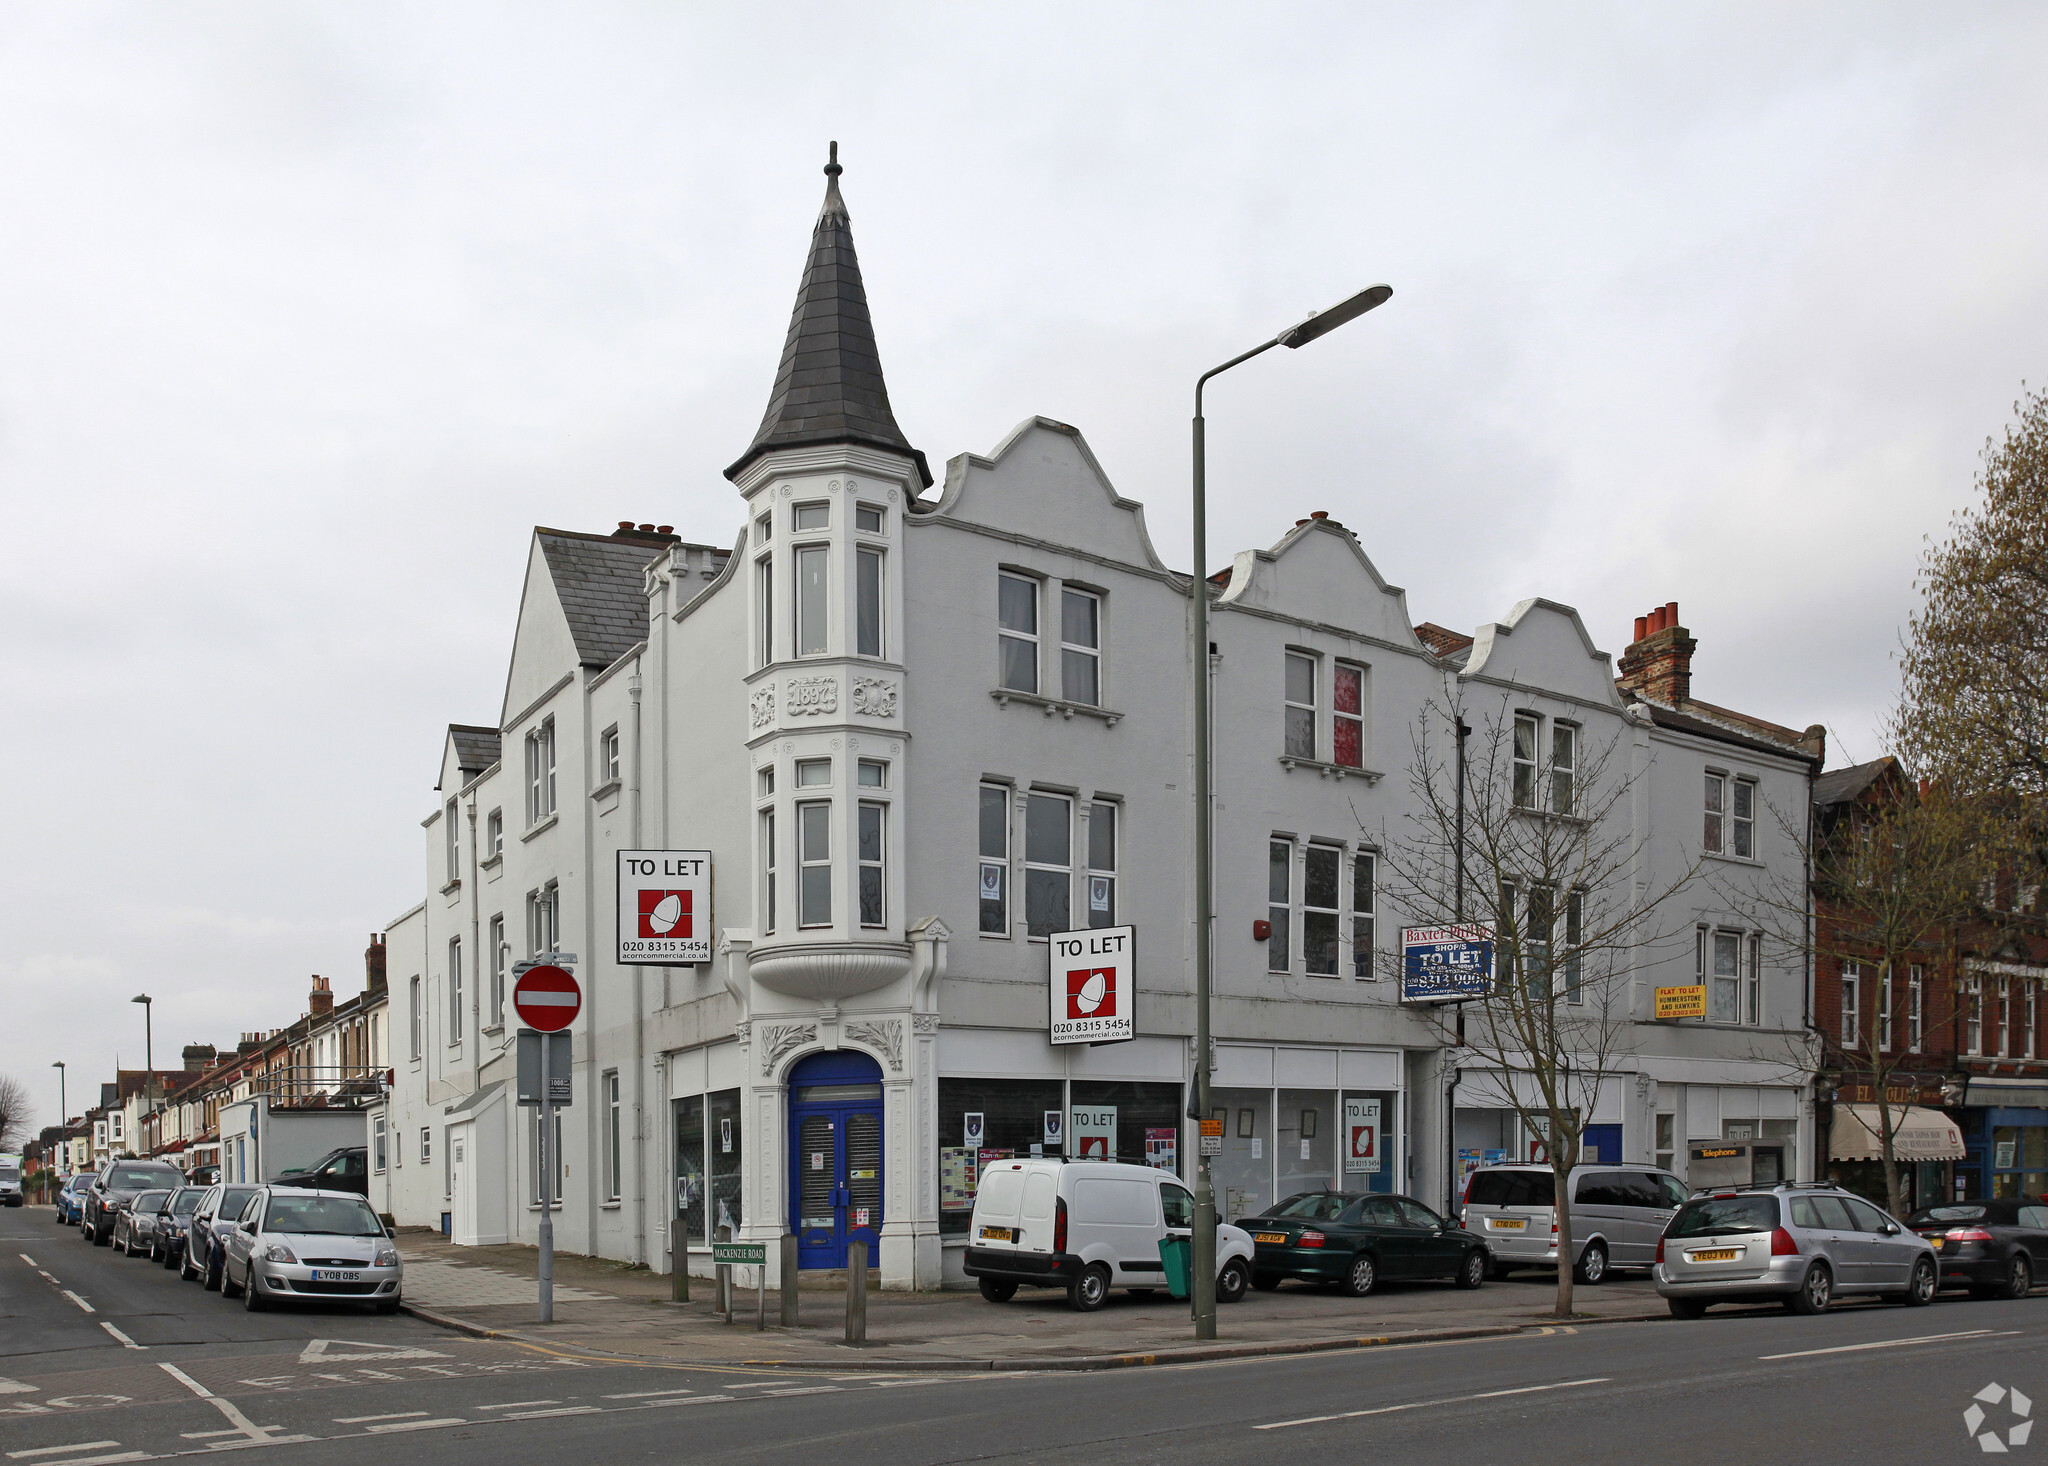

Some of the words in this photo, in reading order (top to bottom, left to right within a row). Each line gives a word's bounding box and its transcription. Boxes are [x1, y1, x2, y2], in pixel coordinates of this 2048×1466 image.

[796, 686, 830, 706] 1897
[627, 860, 656, 876] TO
[665, 860, 704, 876] LET
[1406, 929, 1446, 943] Baxter
[623, 942, 644, 951] 020
[648, 942, 676, 951] 8315
[680, 942, 708, 951] 5454
[1057, 940, 1083, 957] TO
[1091, 935, 1127, 954] LET
[1420, 952, 1443, 966] TO
[1448, 950, 1482, 965] LET
[1053, 1023, 1073, 1033] 020
[1075, 1021, 1101, 1032] 8315
[1105, 1019, 1130, 1029] 5454
[1053, 1030, 1131, 1041] acorncommercial.co.uk
[1856, 1086, 1871, 1101] EL
[1347, 1106, 1359, 1116] TO
[1362, 1106, 1379, 1116] LET
[1073, 1113, 1089, 1126] TO
[1093, 1113, 1115, 1126] LET
[1701, 1149, 1737, 1158] Telephone
[714, 1248, 746, 1259] MACKENZIE
[748, 1249, 764, 1259] ROAD
[1697, 1251, 1717, 1260] YE03
[1719, 1250, 1735, 1259] VVV
[318, 1271, 341, 1280] LY08
[342, 1272, 360, 1280] OBS
